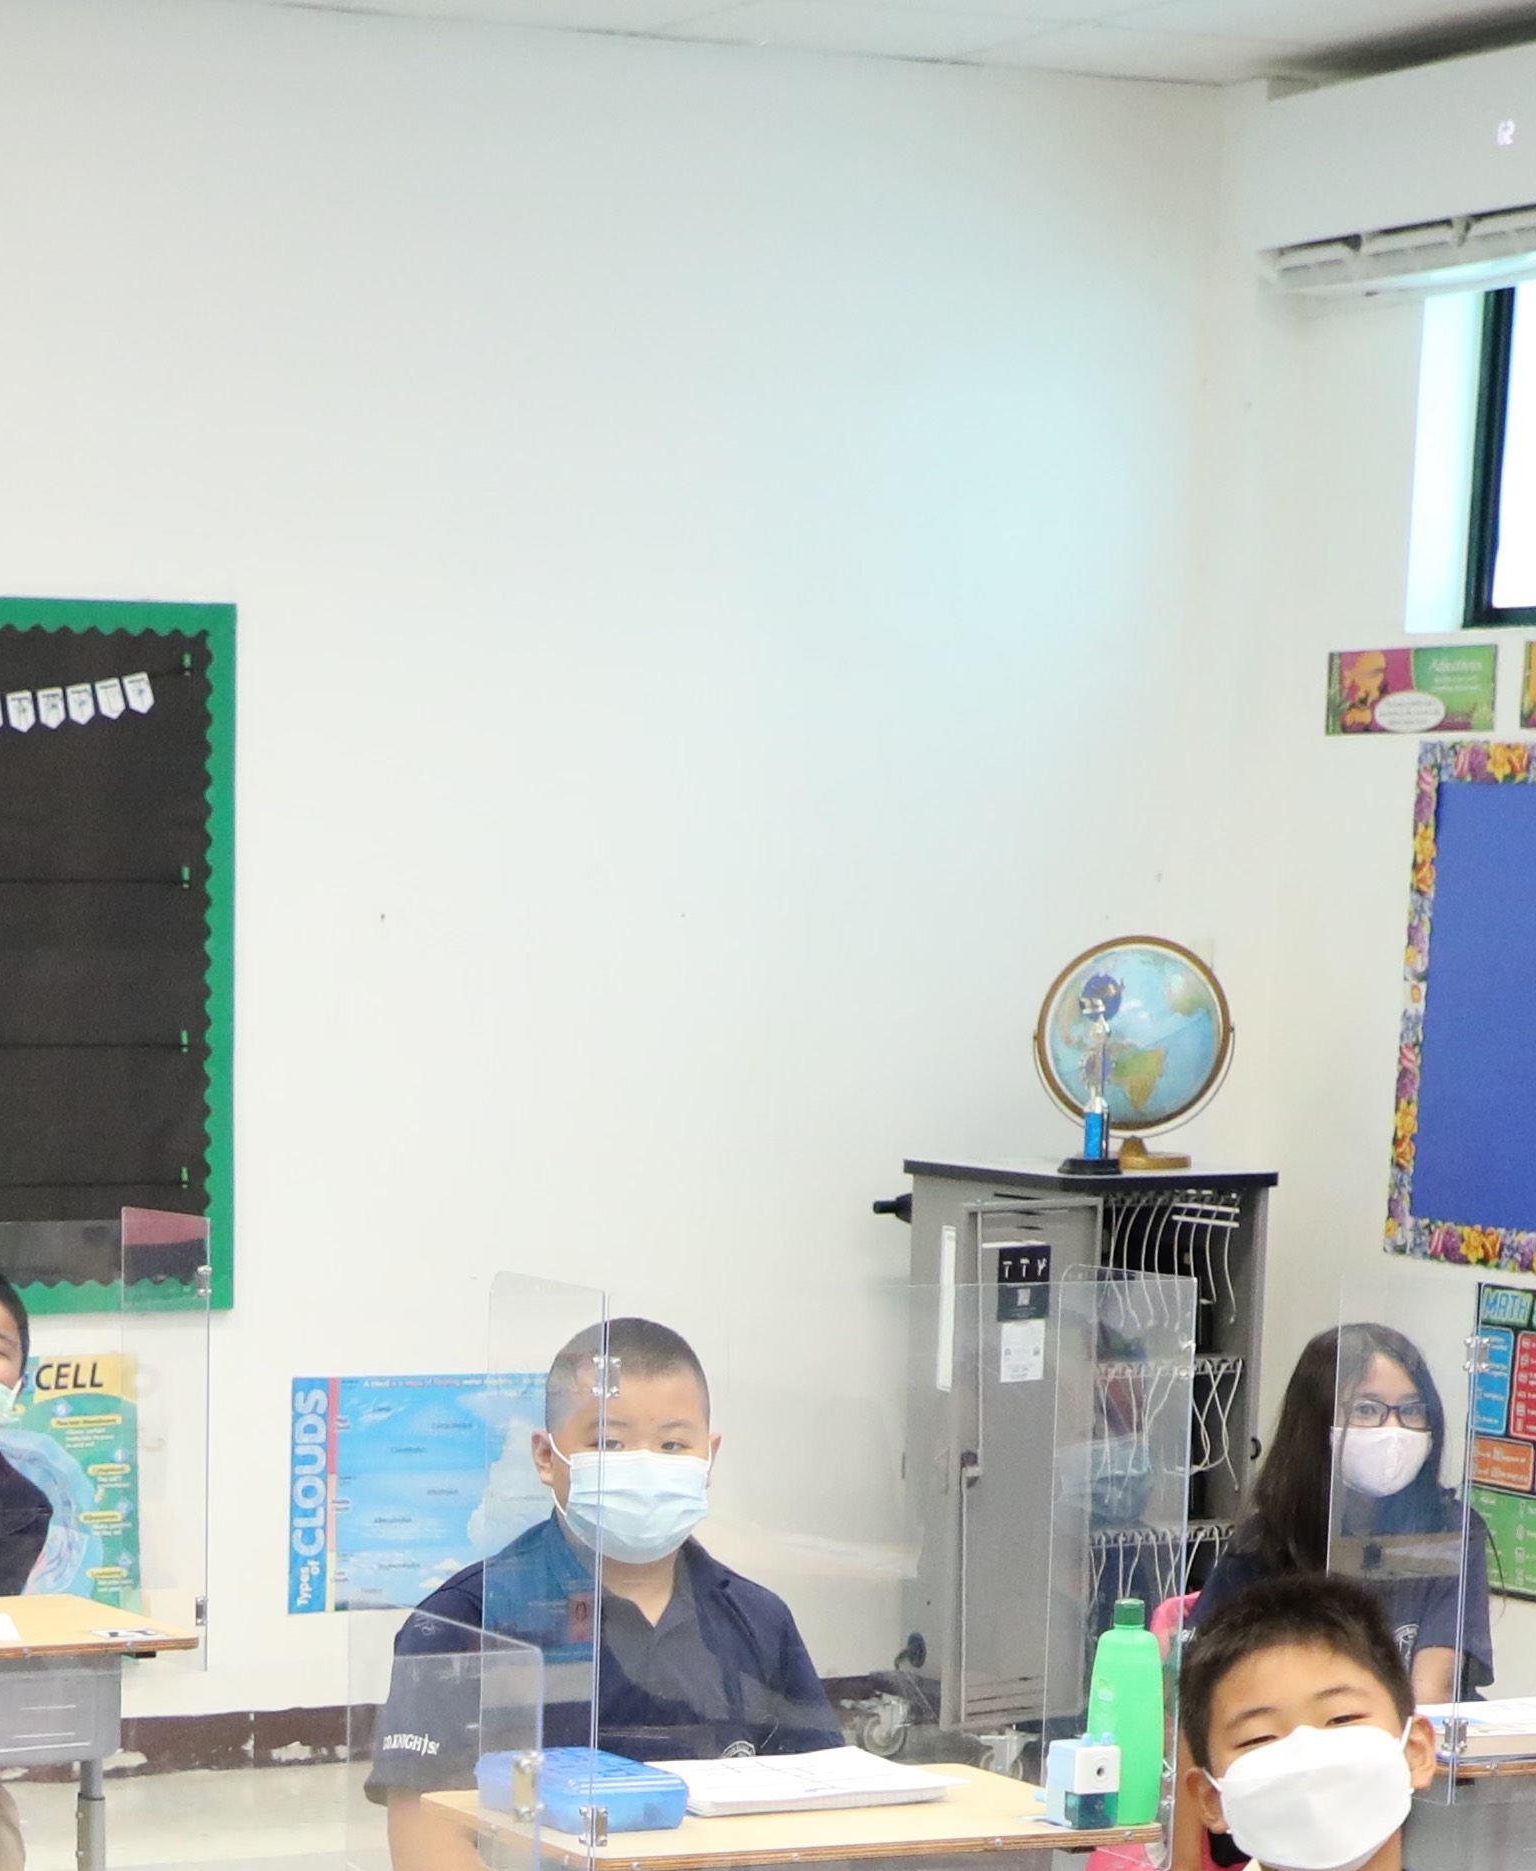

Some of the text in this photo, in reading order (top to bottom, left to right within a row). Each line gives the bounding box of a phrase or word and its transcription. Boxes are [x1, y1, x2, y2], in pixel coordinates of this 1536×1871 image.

[1485, 1289, 1530, 1323] MATH
[35, 1362, 104, 1390] CELL
[293, 1388, 327, 1607] Types of CLOUDS
